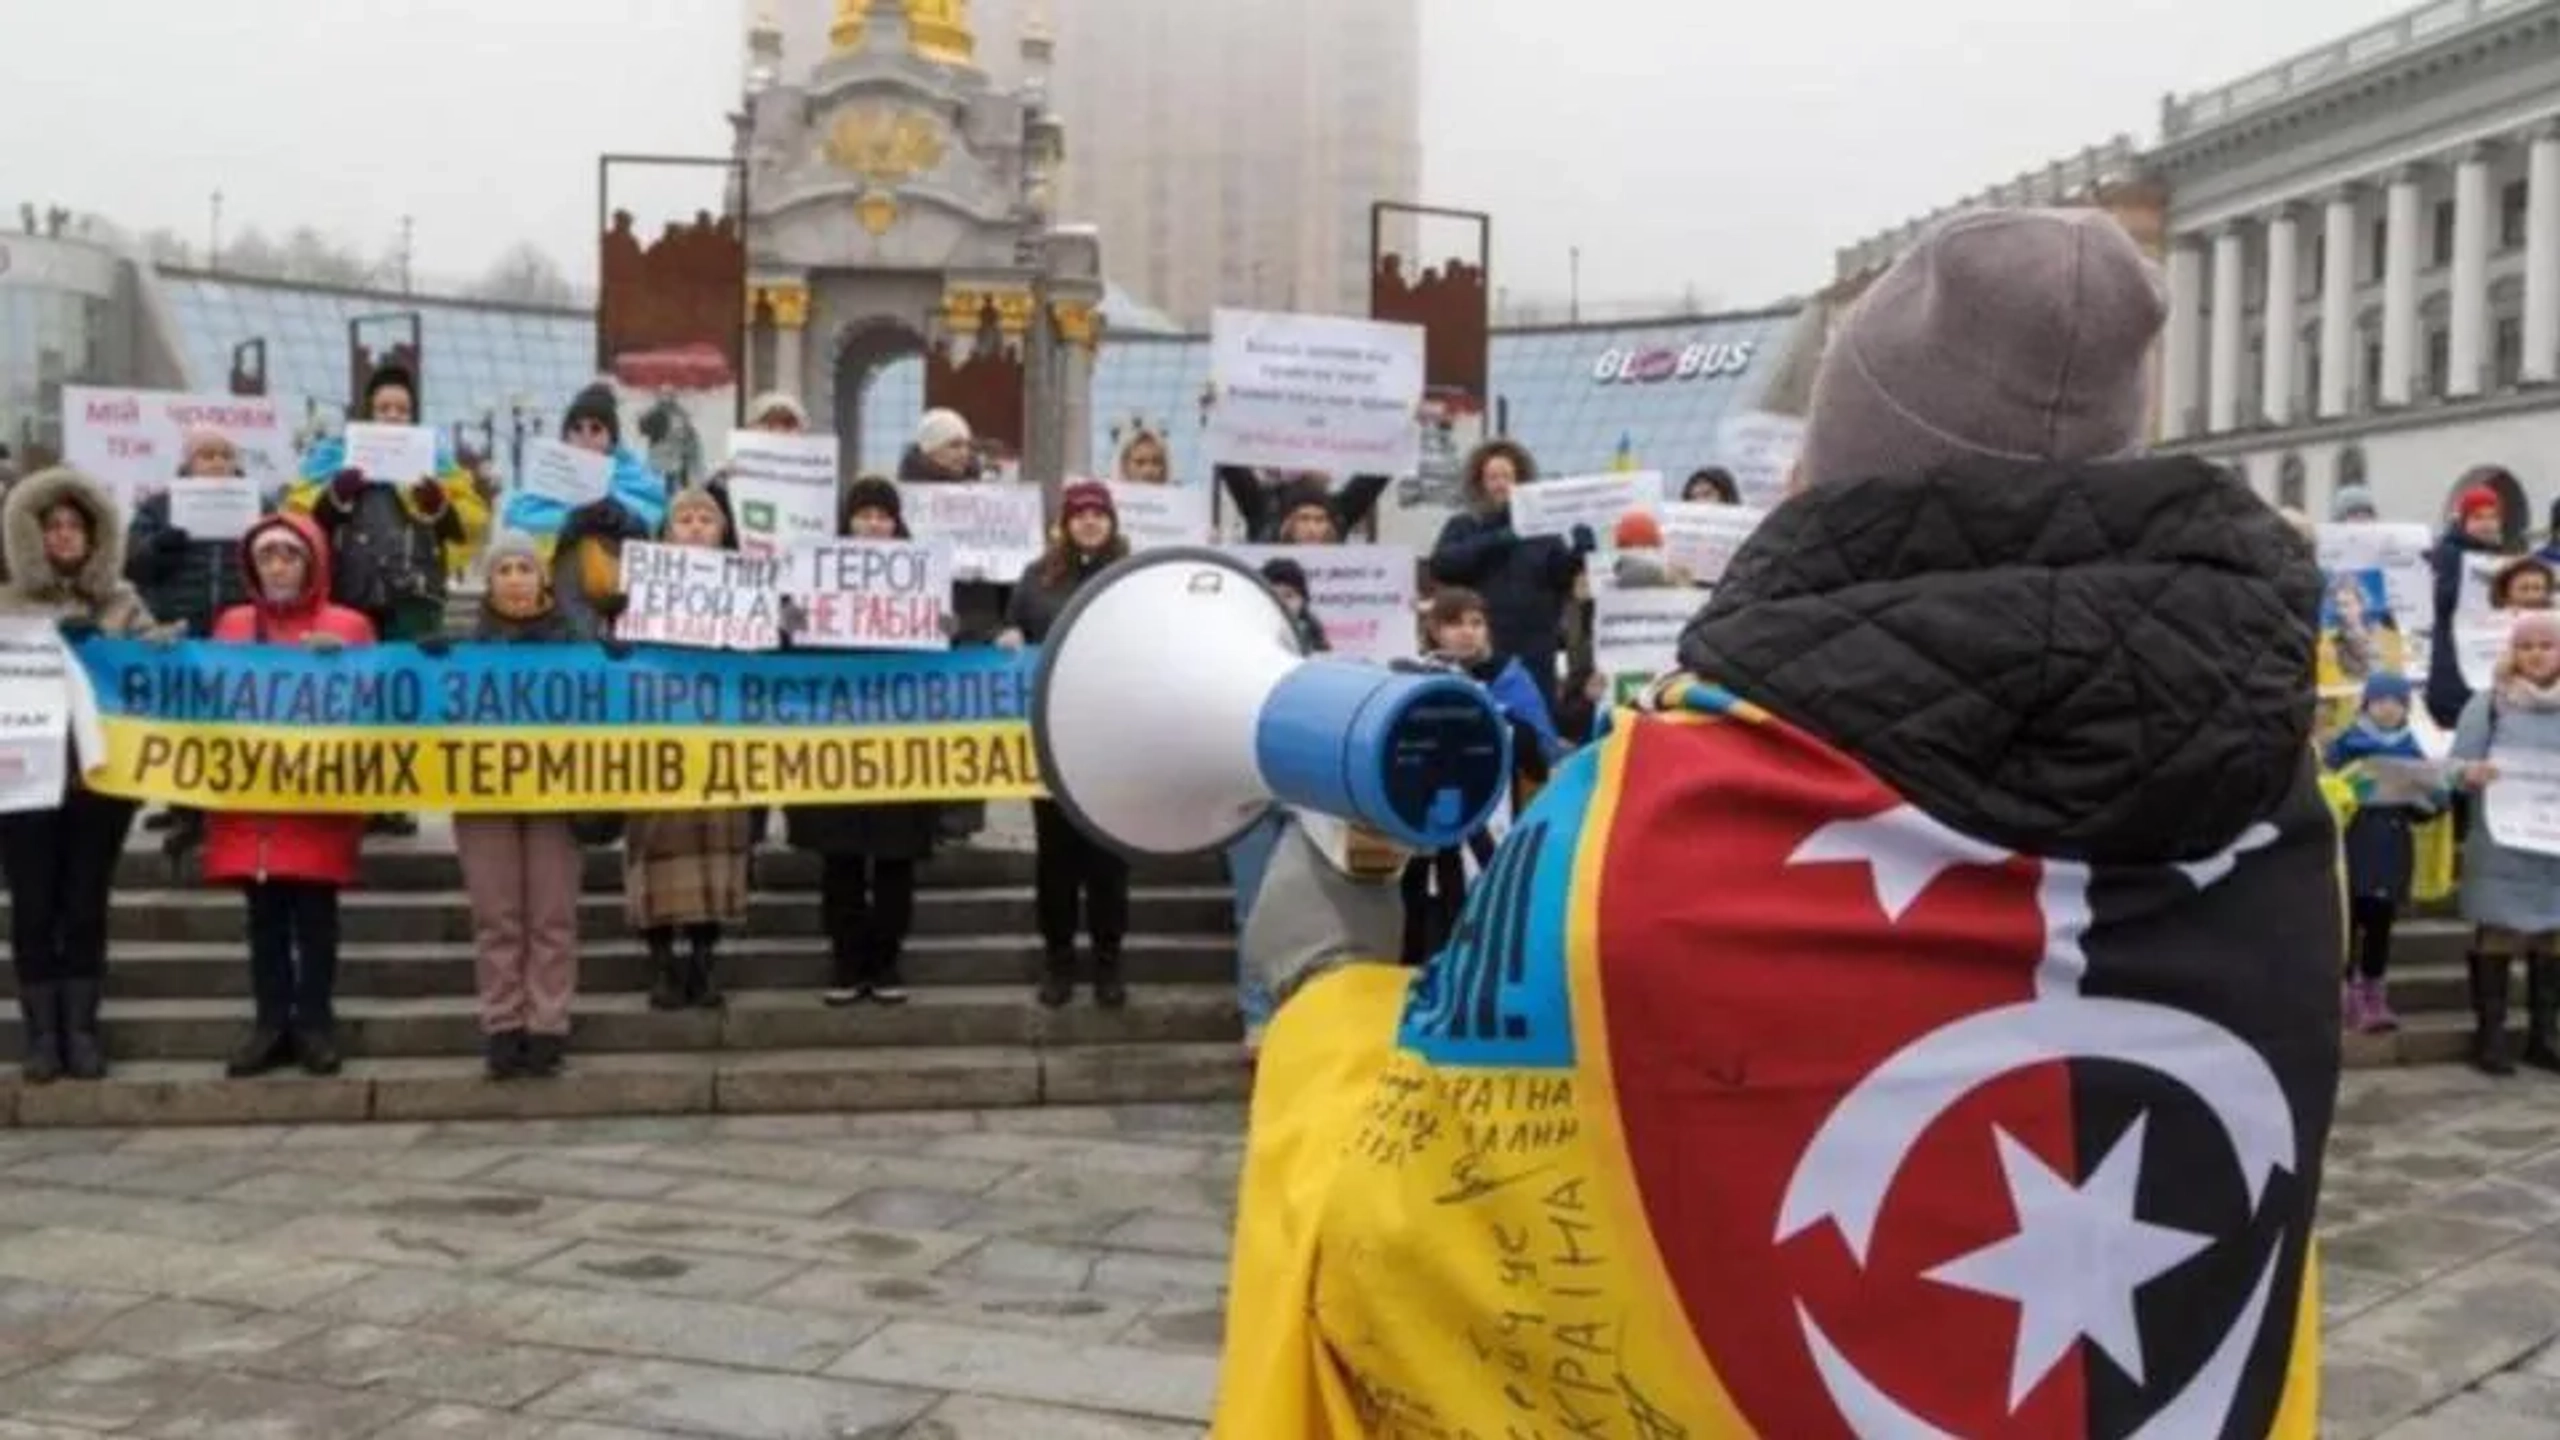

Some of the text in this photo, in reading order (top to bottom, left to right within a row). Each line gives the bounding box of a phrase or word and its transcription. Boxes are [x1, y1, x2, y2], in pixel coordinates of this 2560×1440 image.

[1593, 342, 1752, 384] GLOBUS
[814, 547, 929, 592] ГЕРОЇ
[120, 663, 423, 724] ВИМАГАЄМО
[443, 668, 608, 724] ЗАКОН
[627, 671, 722, 724] ПРО
[133, 735, 423, 796] РОЗУМНИХ
[438, 740, 685, 796] ТЕРМІНІВ
